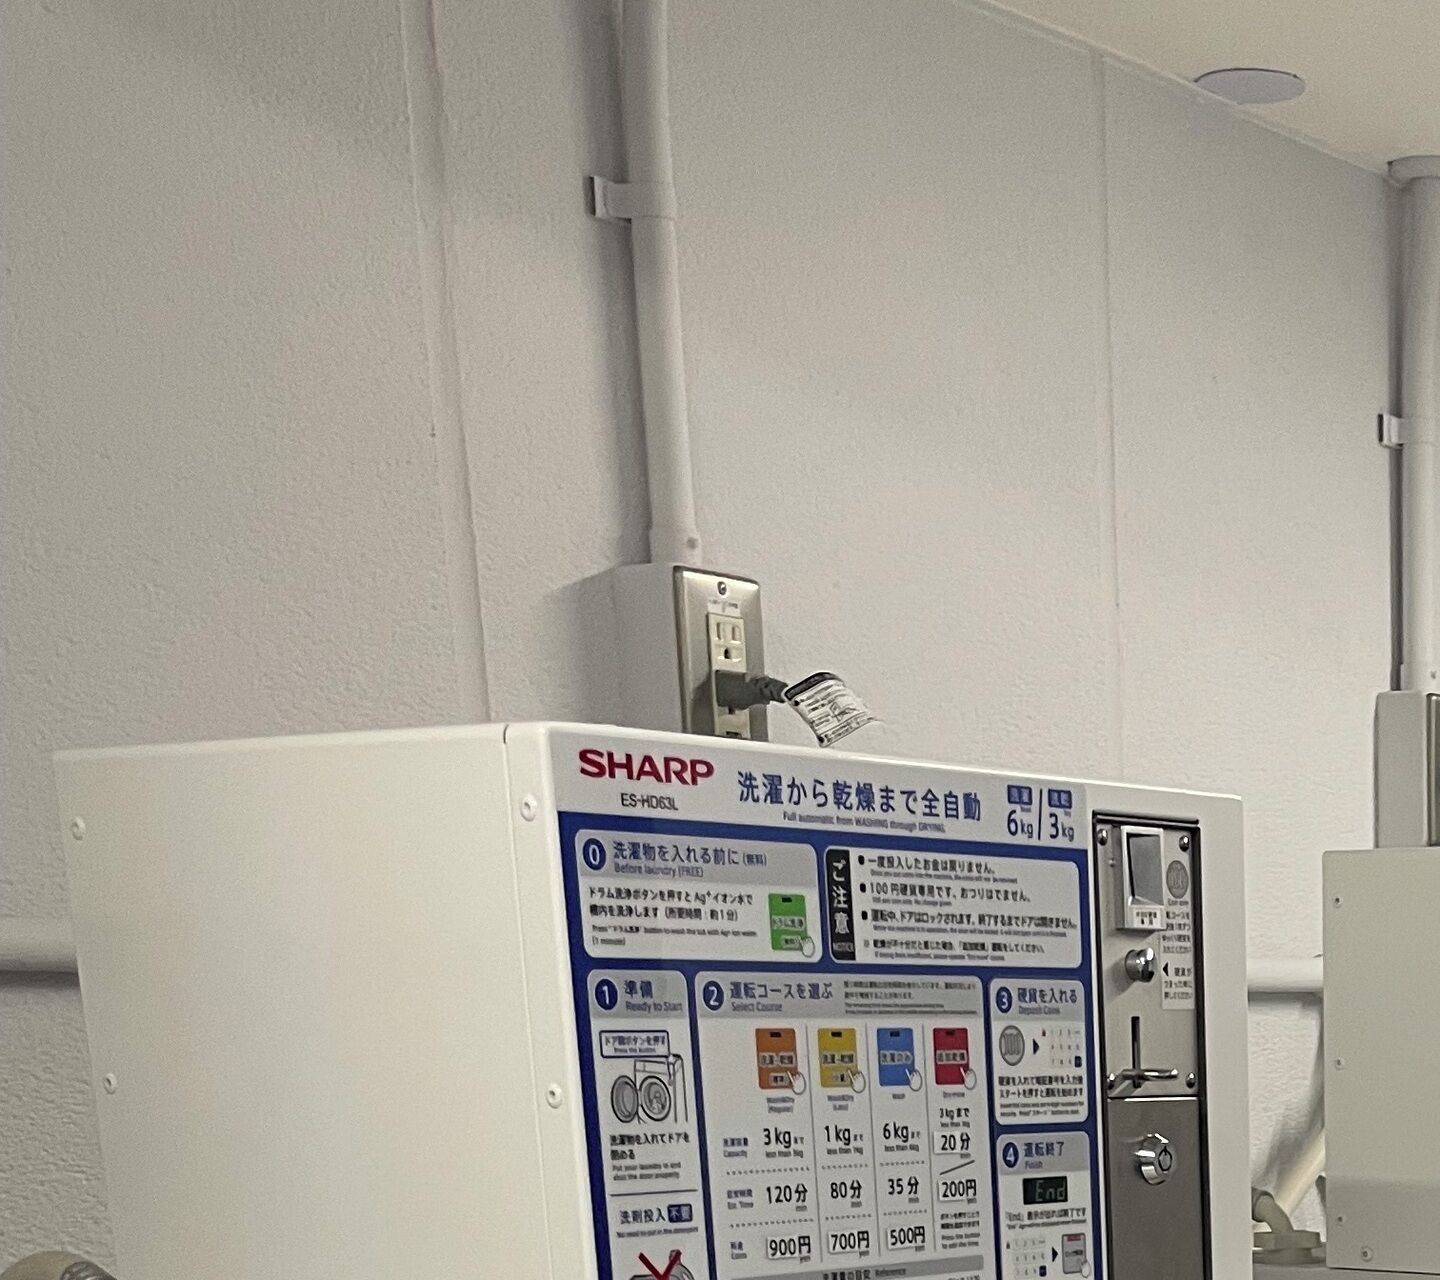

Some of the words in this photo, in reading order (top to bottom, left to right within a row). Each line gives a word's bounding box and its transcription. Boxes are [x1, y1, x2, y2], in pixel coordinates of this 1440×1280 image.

[578, 749, 714, 785] SHARP
[620, 793, 679, 811] ES-HD63L
[737, 770, 981, 822] 洗濯から乾燥まで全自動
[1007, 809, 1033, 838] 6kg
[1049, 813, 1075, 842] 3kg
[613, 841, 740, 866] 洗濯物を入れる前に
[614, 863, 643, 875] Before
[831, 859, 850, 934] ご注意
[709, 987, 719, 1006] 2
[730, 981, 833, 1000] 運転コースを選ぶ
[1000, 991, 1009, 1009] 3
[1017, 987, 1078, 1004] 硬貨を入れる
[625, 1001, 652, 1013] Ready
[731, 1002, 754, 1012] Select
[1006, 1146, 1016, 1164] 4
[1024, 1141, 1065, 1157] 運転終了
[766, 1183, 808, 1205] 120分
[830, 1179, 862, 1199] 80分
[888, 1176, 919, 1196] 35分
[942, 1178, 977, 1198] 200円
[1036, 1178, 1066, 1202] End
[769, 1235, 811, 1256] 900円
[830, 1230, 870, 1251] 700円
[889, 1225, 926, 1246] 500円
